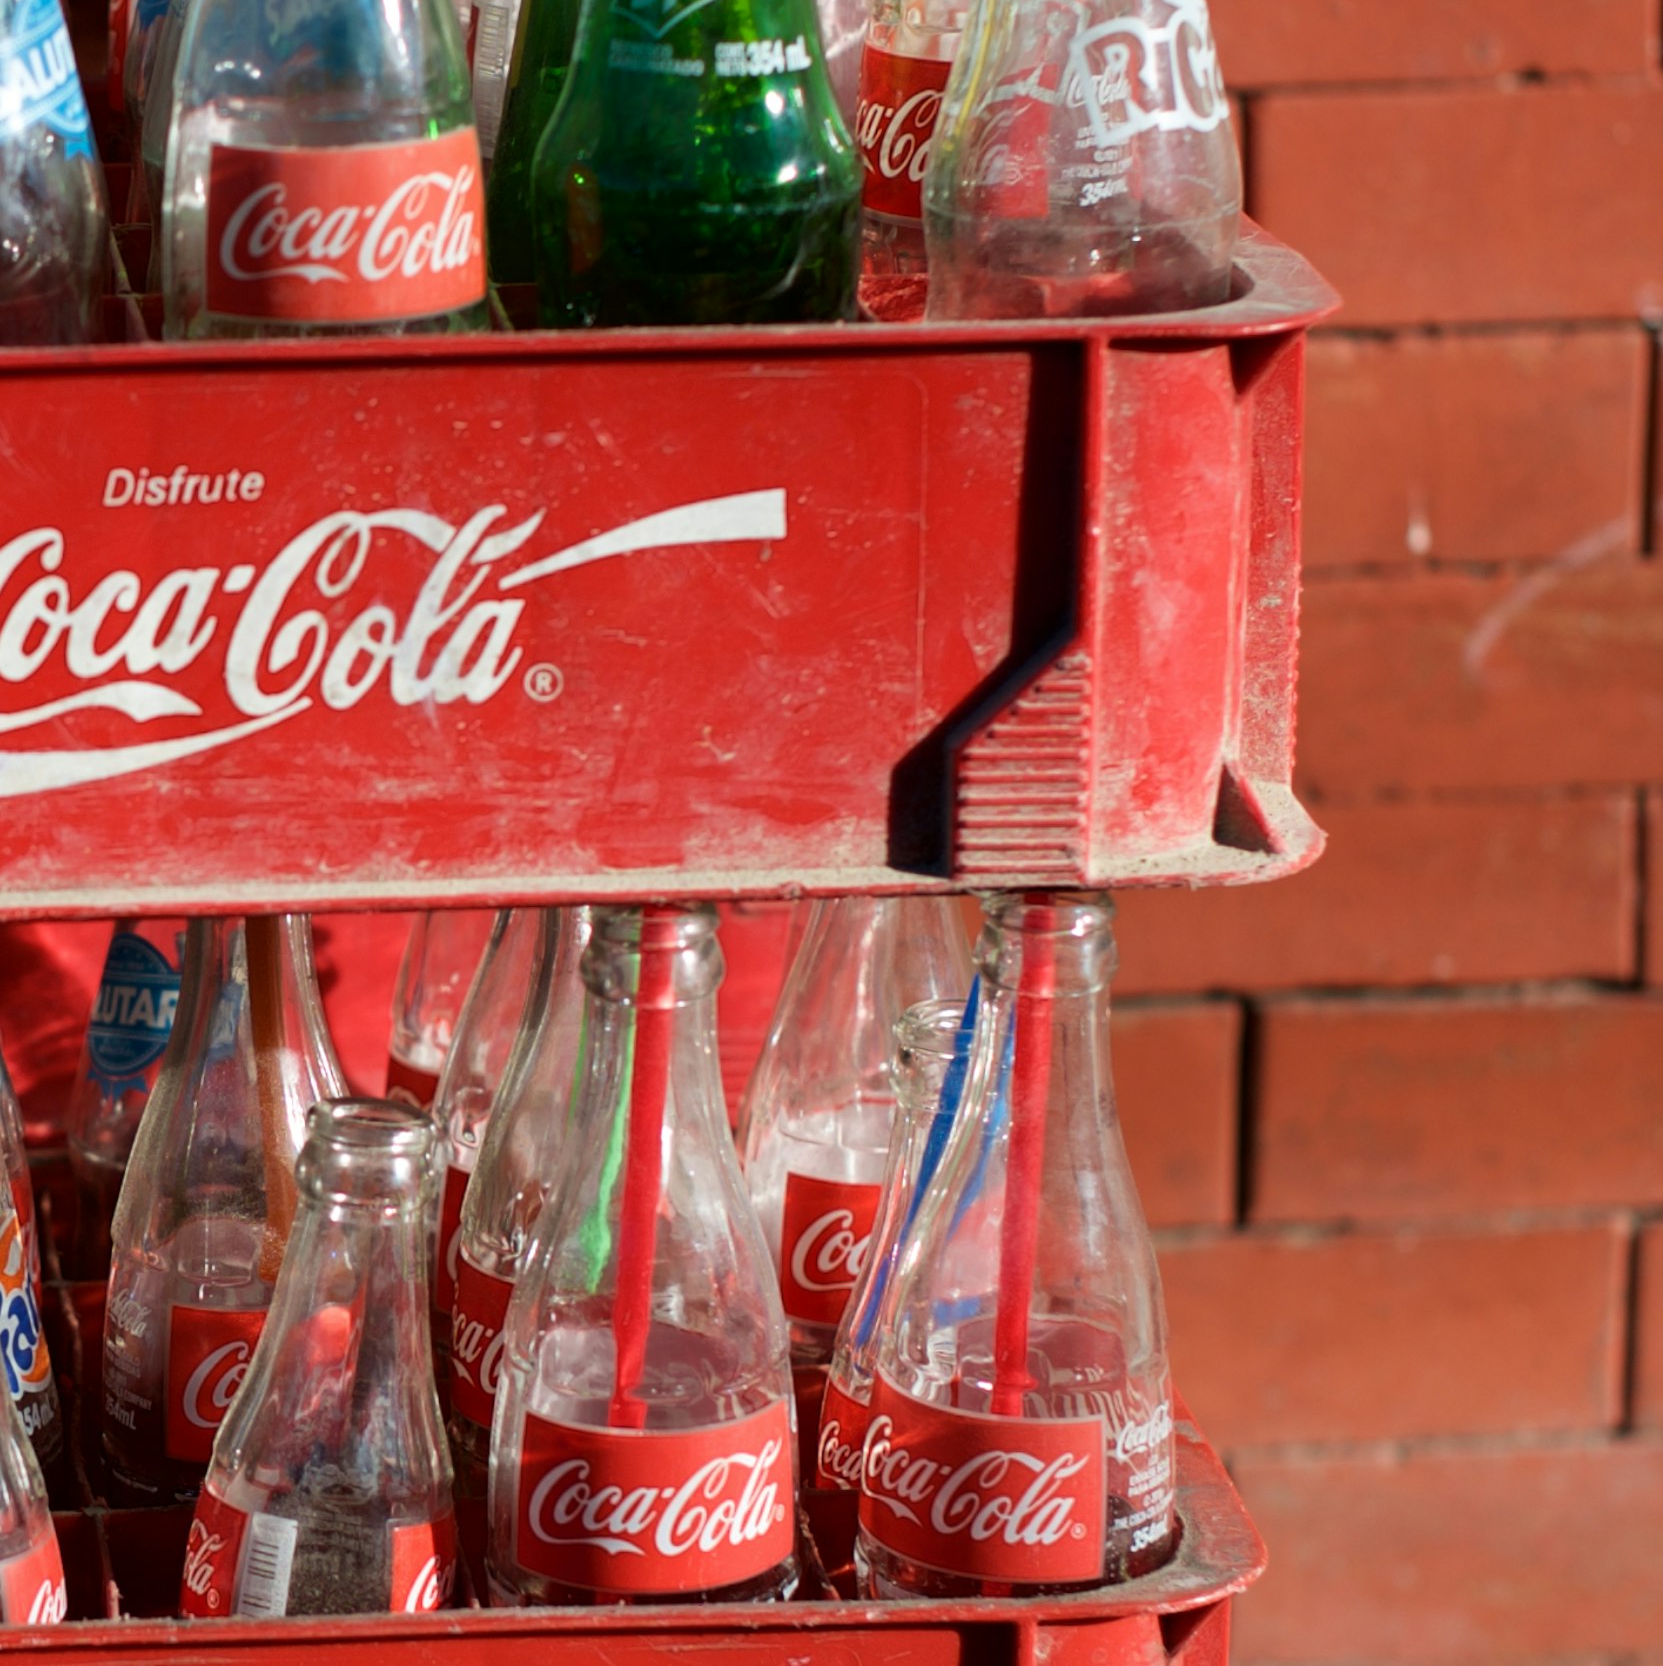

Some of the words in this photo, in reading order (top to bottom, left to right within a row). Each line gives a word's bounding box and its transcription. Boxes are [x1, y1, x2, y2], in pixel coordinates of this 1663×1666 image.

[220, 164, 475, 284] Coca-Cola
[102, 466, 266, 509] Disfrute
[529, 1437, 782, 1557] Coca-Cola
[861, 1414, 1090, 1546] Coca-Cola
